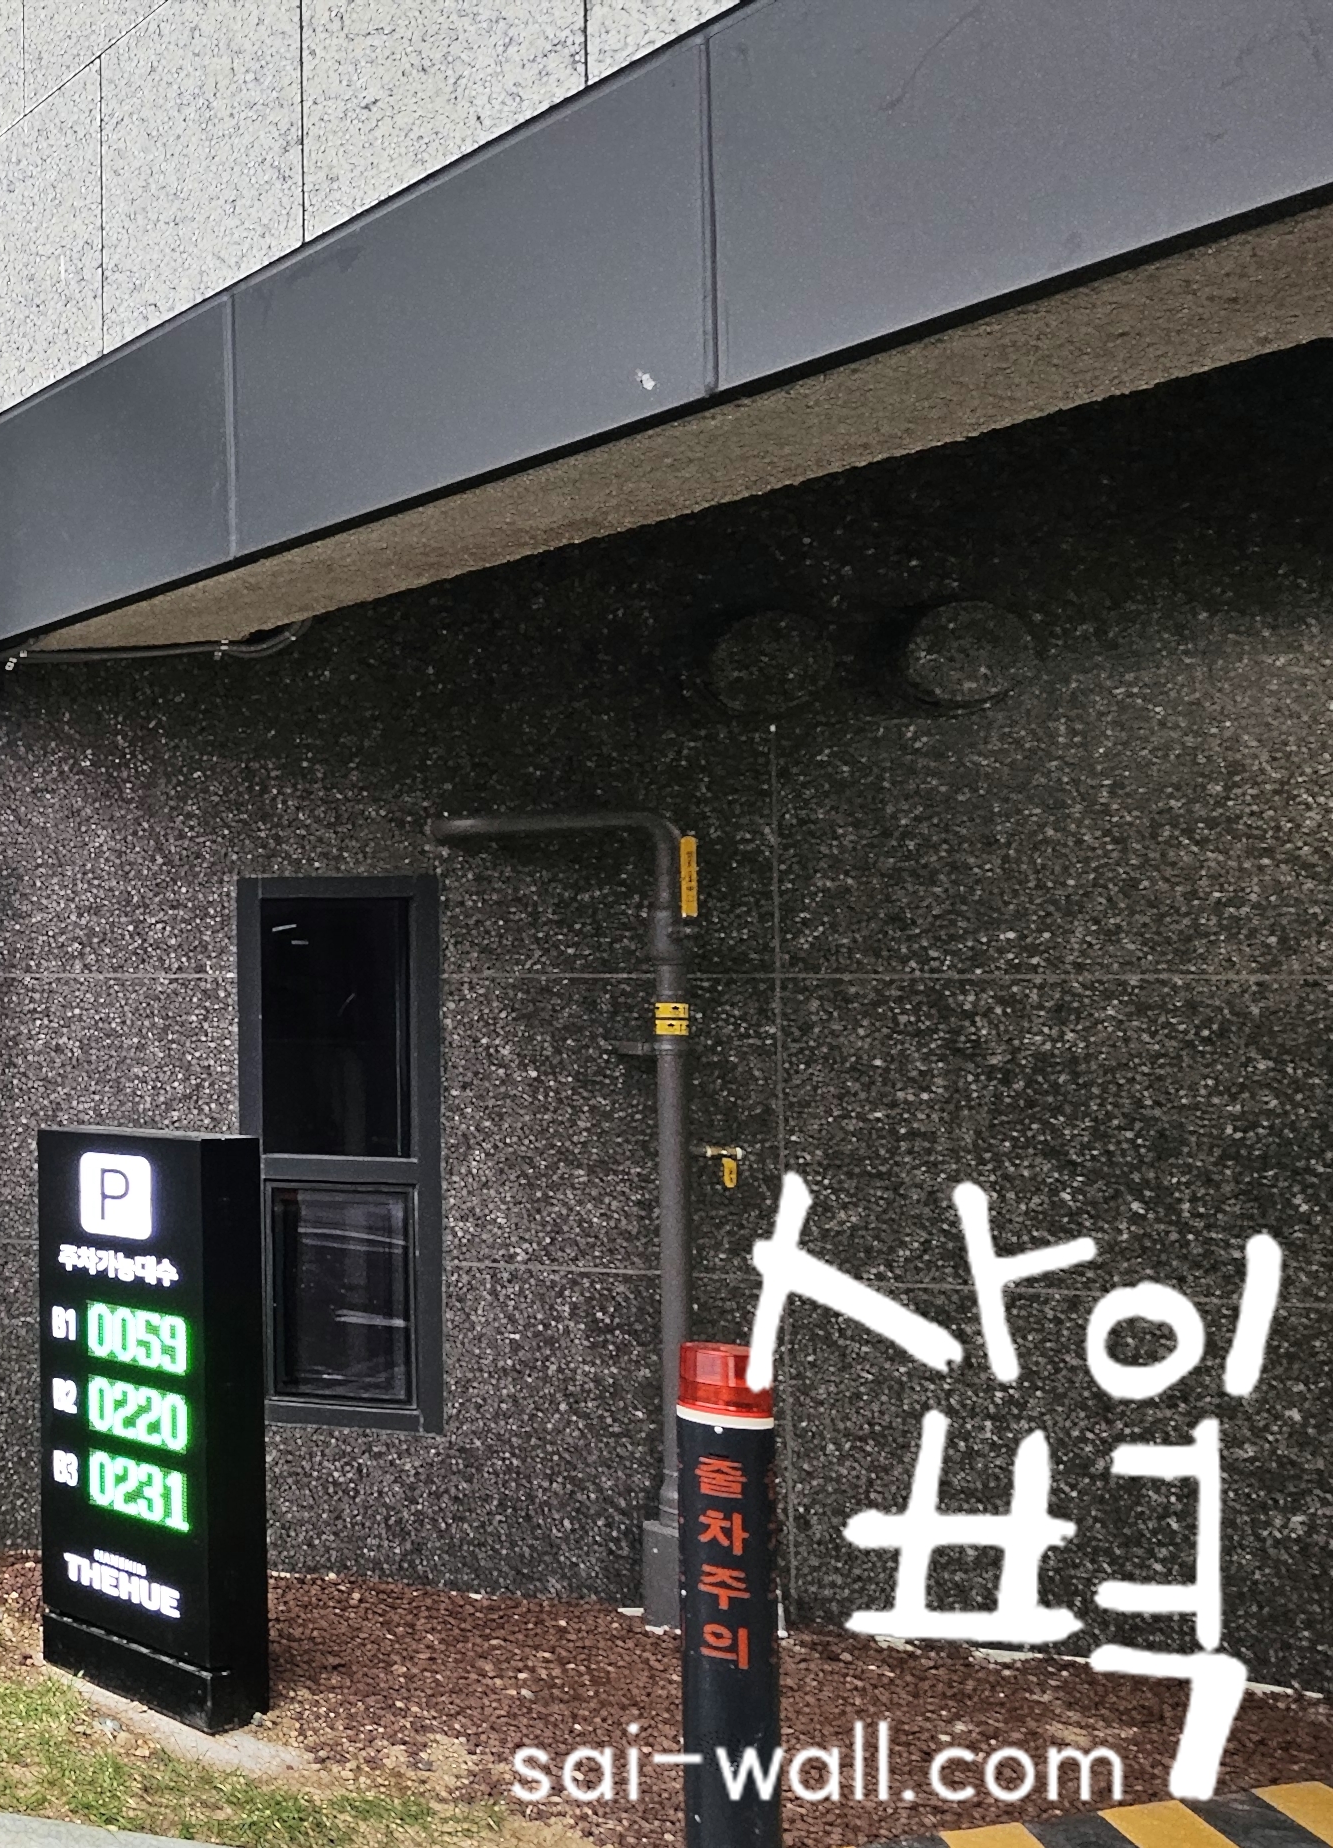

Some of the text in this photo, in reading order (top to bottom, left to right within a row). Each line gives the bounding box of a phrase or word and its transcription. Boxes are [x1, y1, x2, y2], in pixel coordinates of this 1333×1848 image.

[100, 1167, 130, 1220] P
[58, 1244, 179, 1287] 주차가능대수
[51, 1302, 187, 1374] B1 0059
[52, 1376, 188, 1452] B2 0220
[52, 1449, 190, 1534] B3 0231
[63, 1551, 181, 1619] THEHUE
[694, 1455, 752, 1670] 출차주의
